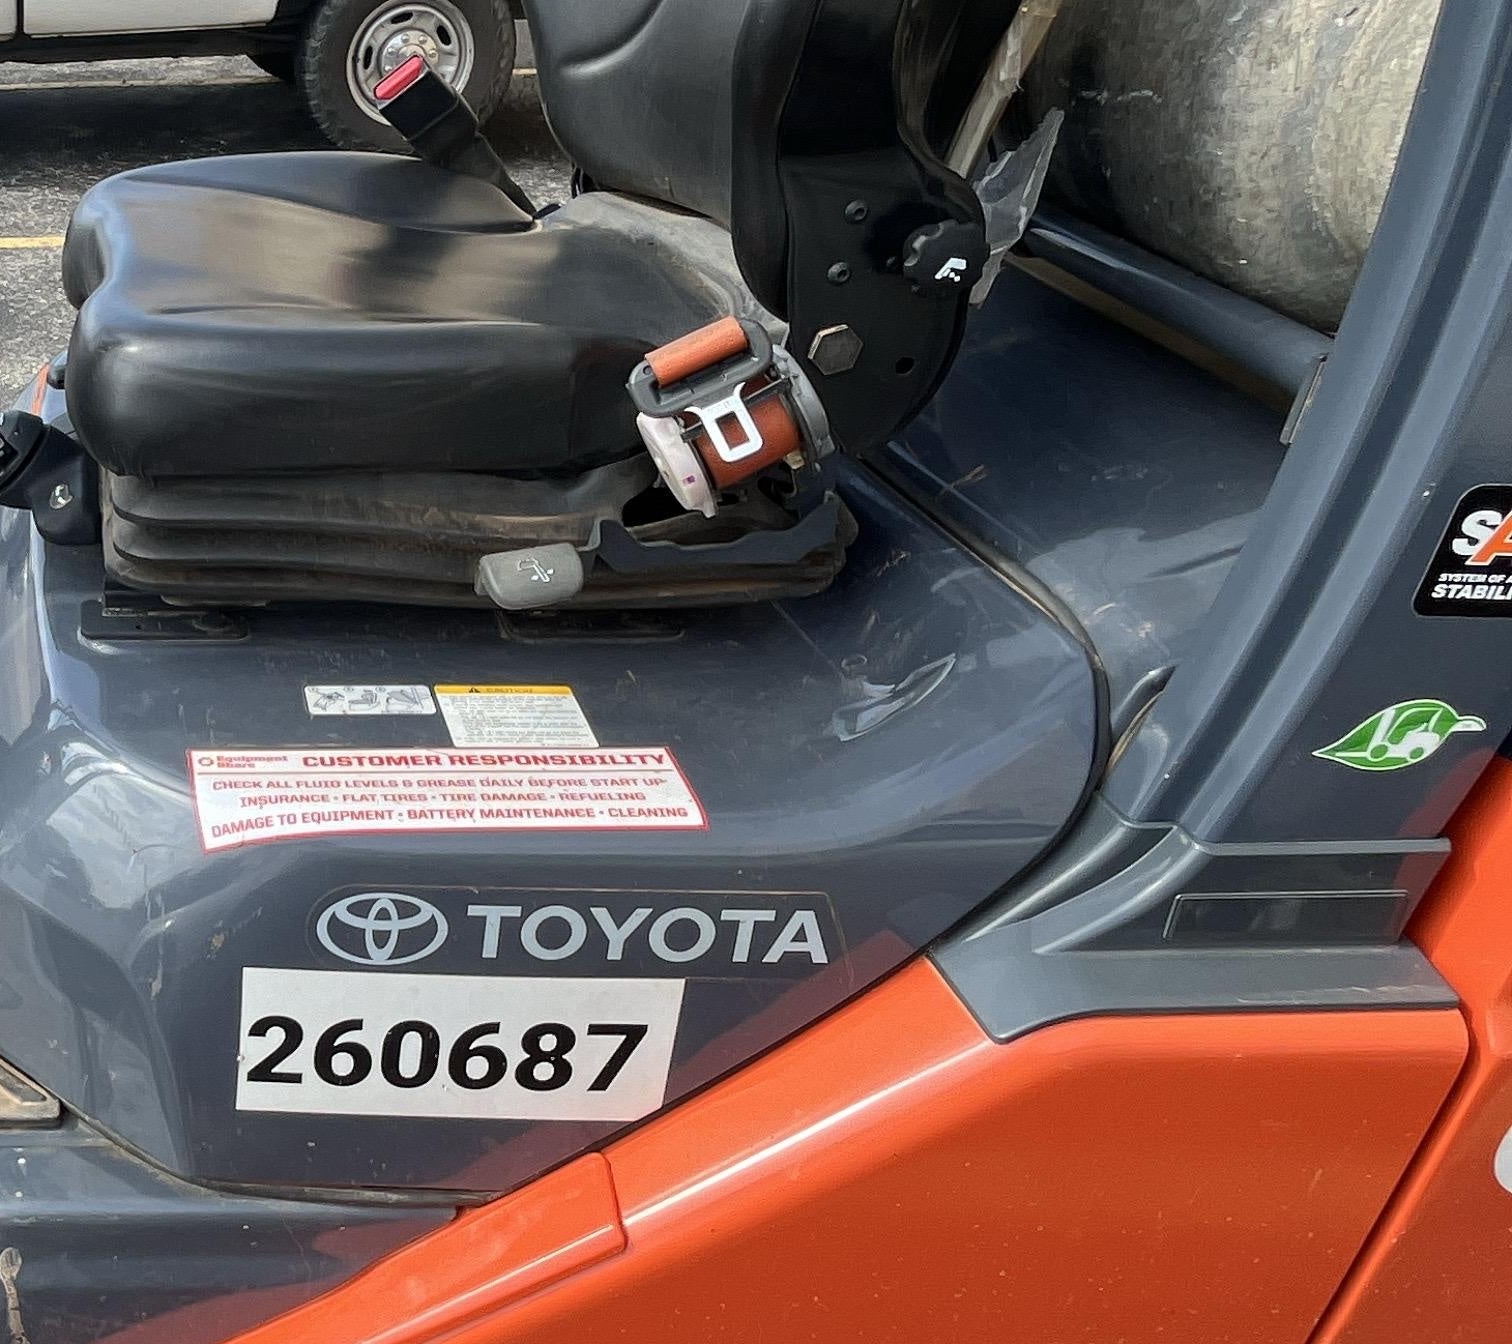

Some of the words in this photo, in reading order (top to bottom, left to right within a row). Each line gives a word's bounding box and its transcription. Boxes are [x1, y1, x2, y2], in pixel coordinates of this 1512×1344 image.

[1438, 573, 1488, 583] SYSTEM
[1487, 574, 1506, 584] OF
[303, 756, 442, 767] CUSTOMER
[448, 754, 664, 765] RESPONSIBILITY
[213, 779, 263, 790] CHECK
[266, 779, 289, 789] ALL
[296, 779, 340, 789] FLUID
[345, 778, 398, 789] LEVELS
[417, 778, 474, 788] GREASE
[479, 777, 523, 787] DAILY
[528, 777, 587, 787] BEFORE
[590, 777, 638, 787] START
[241, 794, 330, 807] INSURANCE
[342, 793, 377, 802] FLAT
[381, 792, 428, 802] TIRES
[440, 792, 477, 802] TIRE
[481, 792, 545, 802] DAMAGE
[559, 792, 646, 801] REFUELING
[211, 815, 274, 838] DAMAGE
[276, 813, 297, 826] TO
[302, 809, 394, 824] EQUIPMENT
[407, 808, 475, 820] BATTERY
[479, 807, 596, 819] MAINTENANCE
[608, 807, 688, 818] CLEANING
[467, 904, 829, 964] TOYOTA
[247, 1015, 648, 1092] 260687
